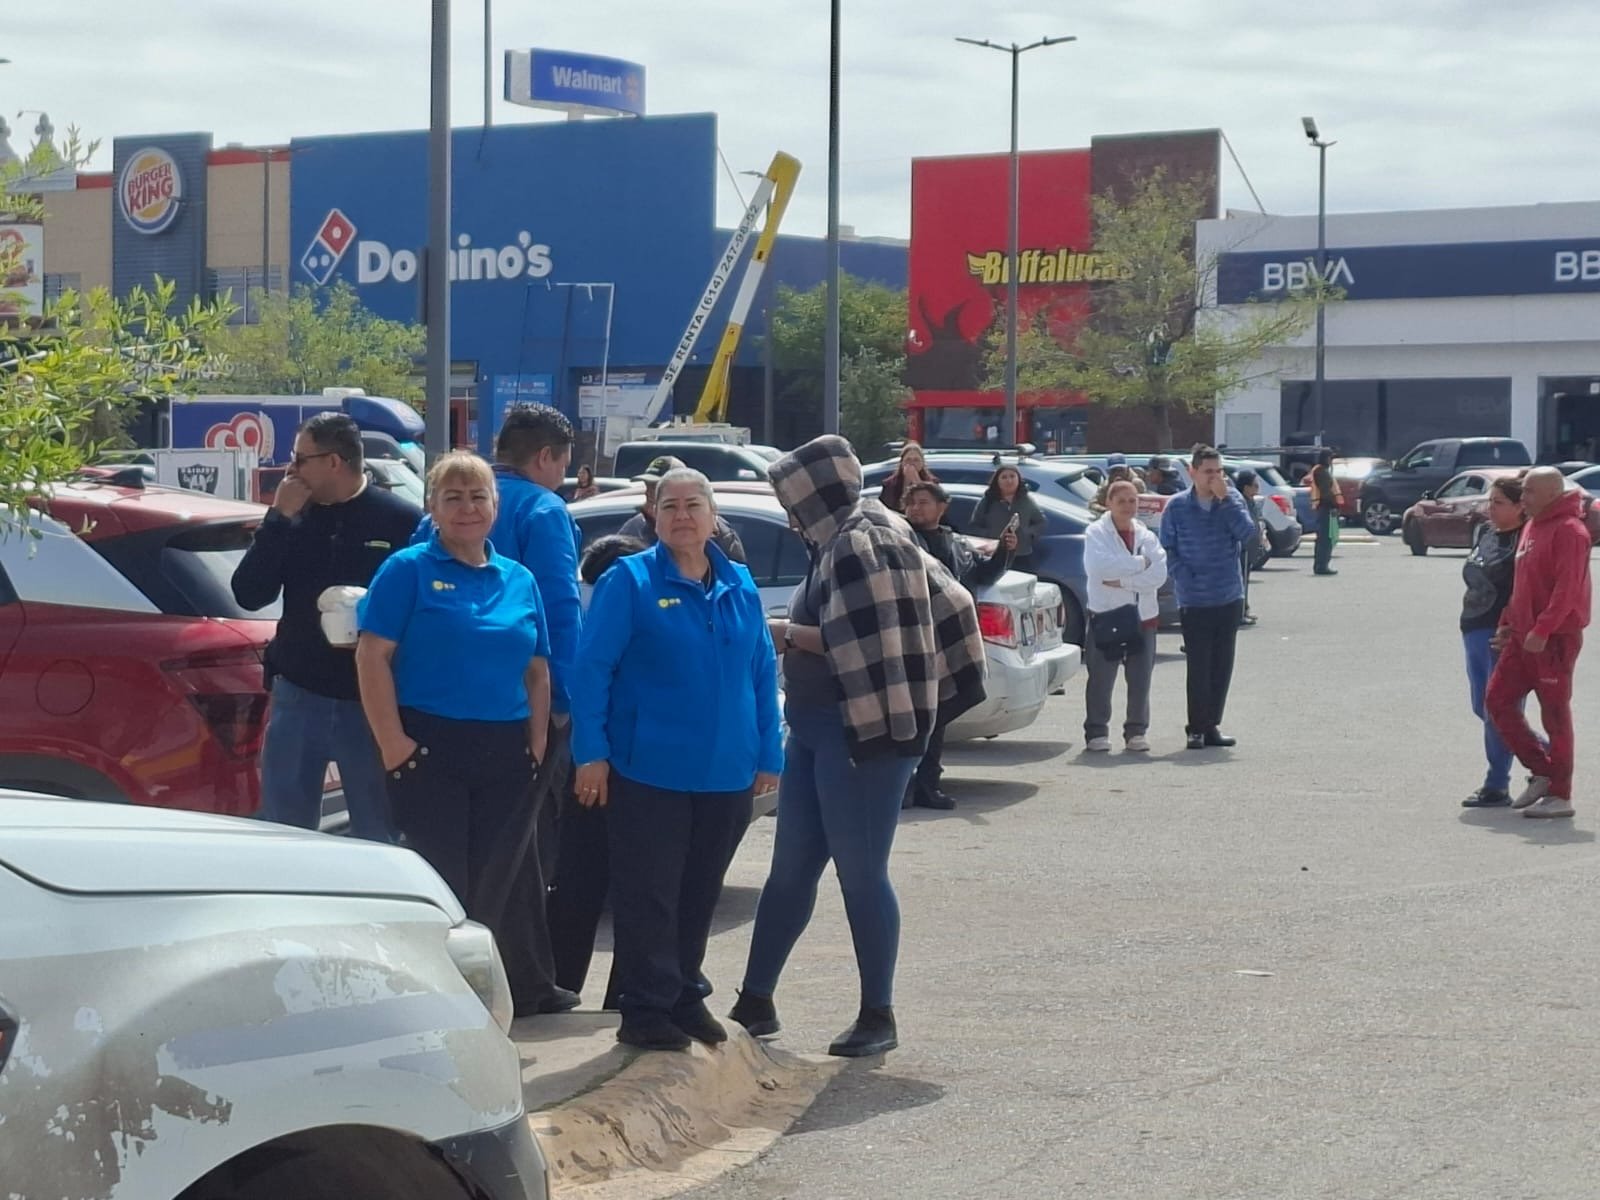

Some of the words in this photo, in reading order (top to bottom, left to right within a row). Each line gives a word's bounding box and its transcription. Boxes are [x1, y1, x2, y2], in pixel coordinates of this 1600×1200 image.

[552, 66, 622, 94] Walmart
[128, 162, 172, 197] BURGER
[130, 177, 173, 214] KING
[358, 230, 553, 283] Doino's
[1263, 256, 1355, 290] BBVA
[665, 363, 679, 382] SE
[676, 314, 704, 361] RENTA
[701, 275, 724, 311] (614)
